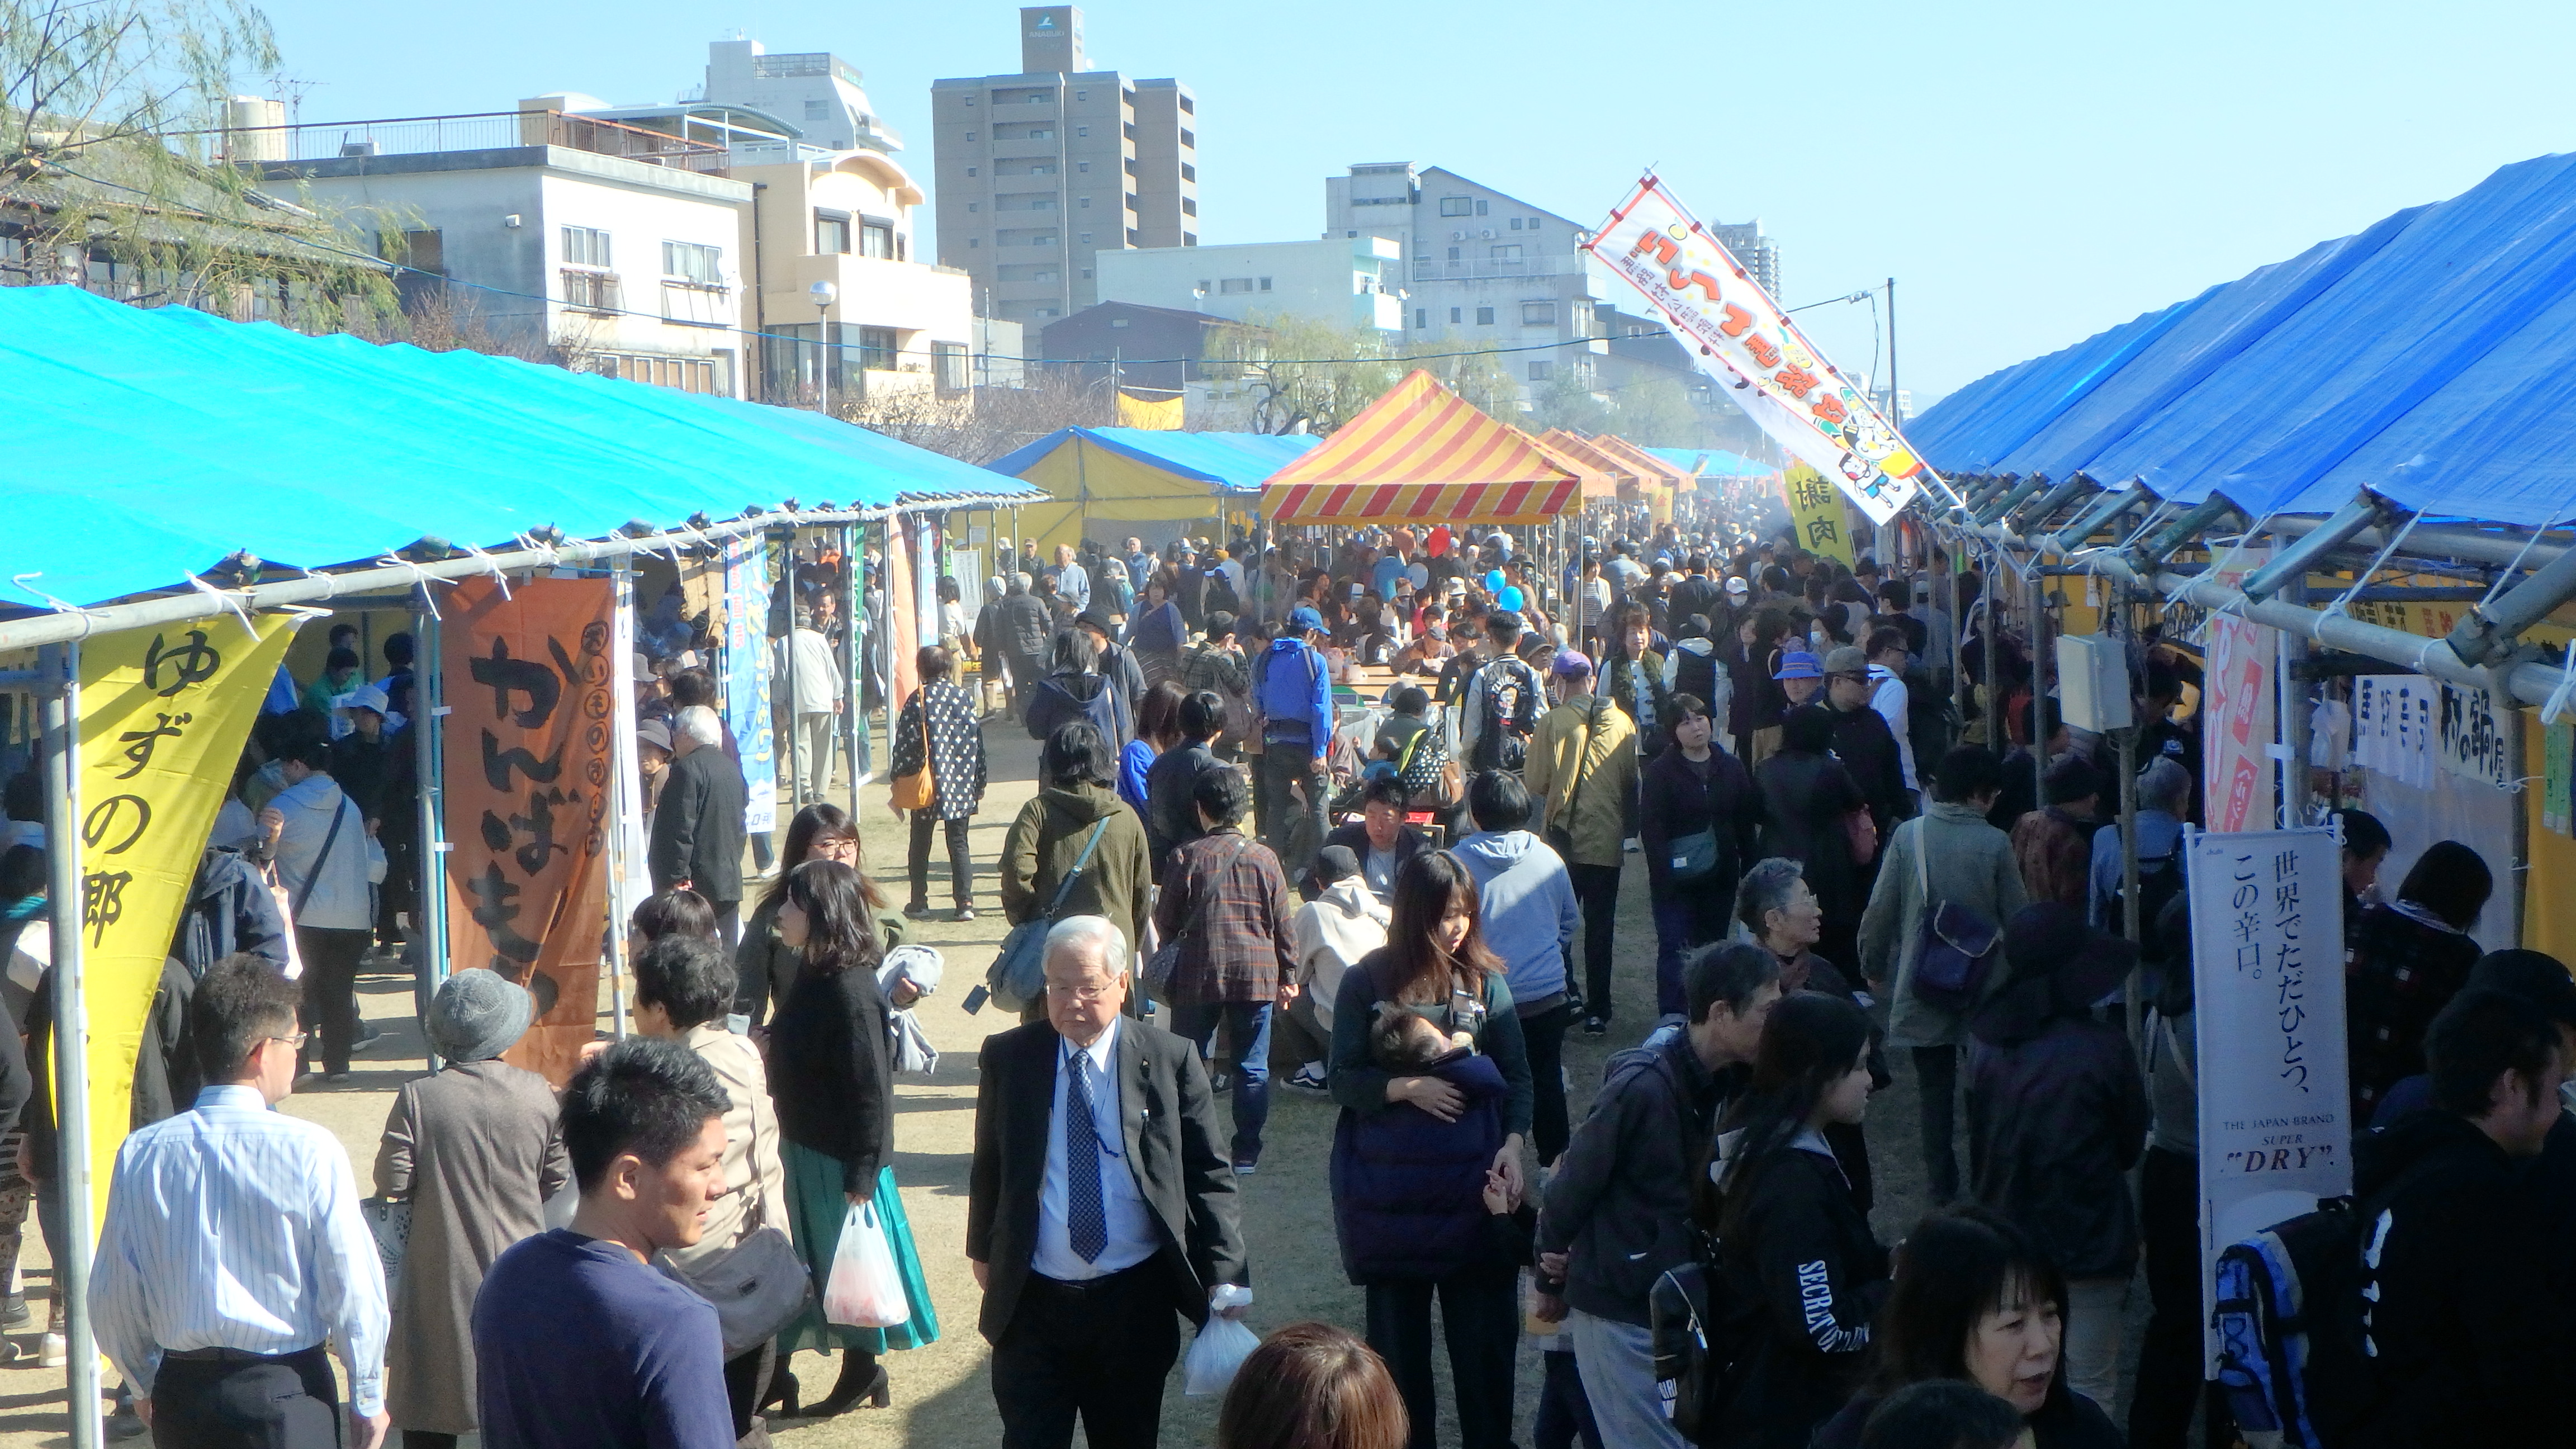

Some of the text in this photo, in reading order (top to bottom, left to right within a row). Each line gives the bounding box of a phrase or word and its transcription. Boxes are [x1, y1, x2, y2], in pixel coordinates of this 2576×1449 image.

[2233, 855, 2262, 979] この辛口。
[2273, 850, 2309, 1092] 世界でただひとつ、
[2223, 1114, 2334, 1130] THE JAPAN BRAND
[2262, 1134, 2303, 1145] SUPER
[1798, 1259, 1836, 1334] SECRET
